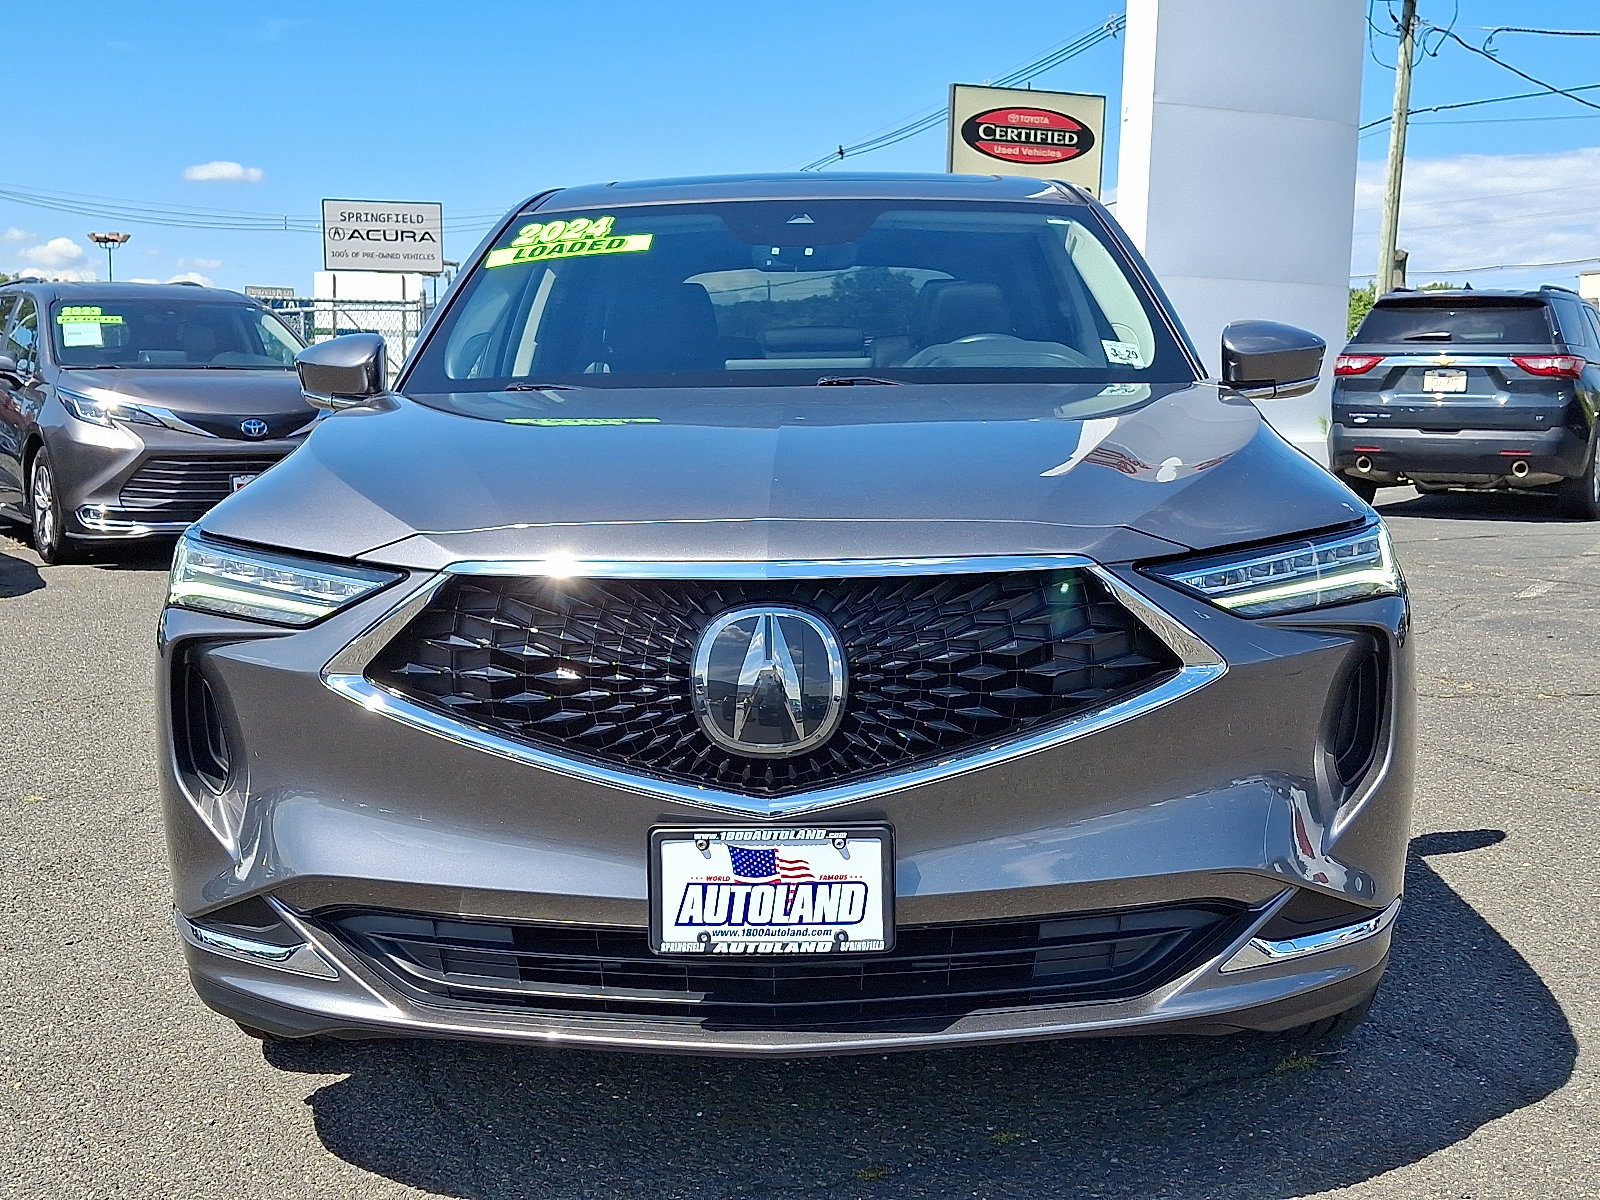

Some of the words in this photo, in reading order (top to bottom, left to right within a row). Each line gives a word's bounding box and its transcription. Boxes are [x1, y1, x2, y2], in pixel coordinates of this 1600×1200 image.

[1020, 114, 1050, 125] TOYOTA
[978, 123, 1078, 145] CERTIFIED
[994, 145, 1019, 155] Used
[1021, 146, 1062, 158] Vehicles
[340, 211, 424, 224] SPRINGFIELD
[347, 229, 437, 243] ACURA
[511, 215, 617, 248] 2024
[362, 252, 400, 260] PRE-OWNED
[512, 238, 627, 261] LOADED
[693, 829, 848, 841] www.1800AUTOLAND.com
[674, 881, 869, 927] AUTOLAND
[712, 928, 832, 937] www.1800Autoland.com
[660, 942, 705, 952] SPRINGFIELD
[712, 941, 833, 954] AUTOLAND
[840, 941, 885, 951] SPRINGFIELD
